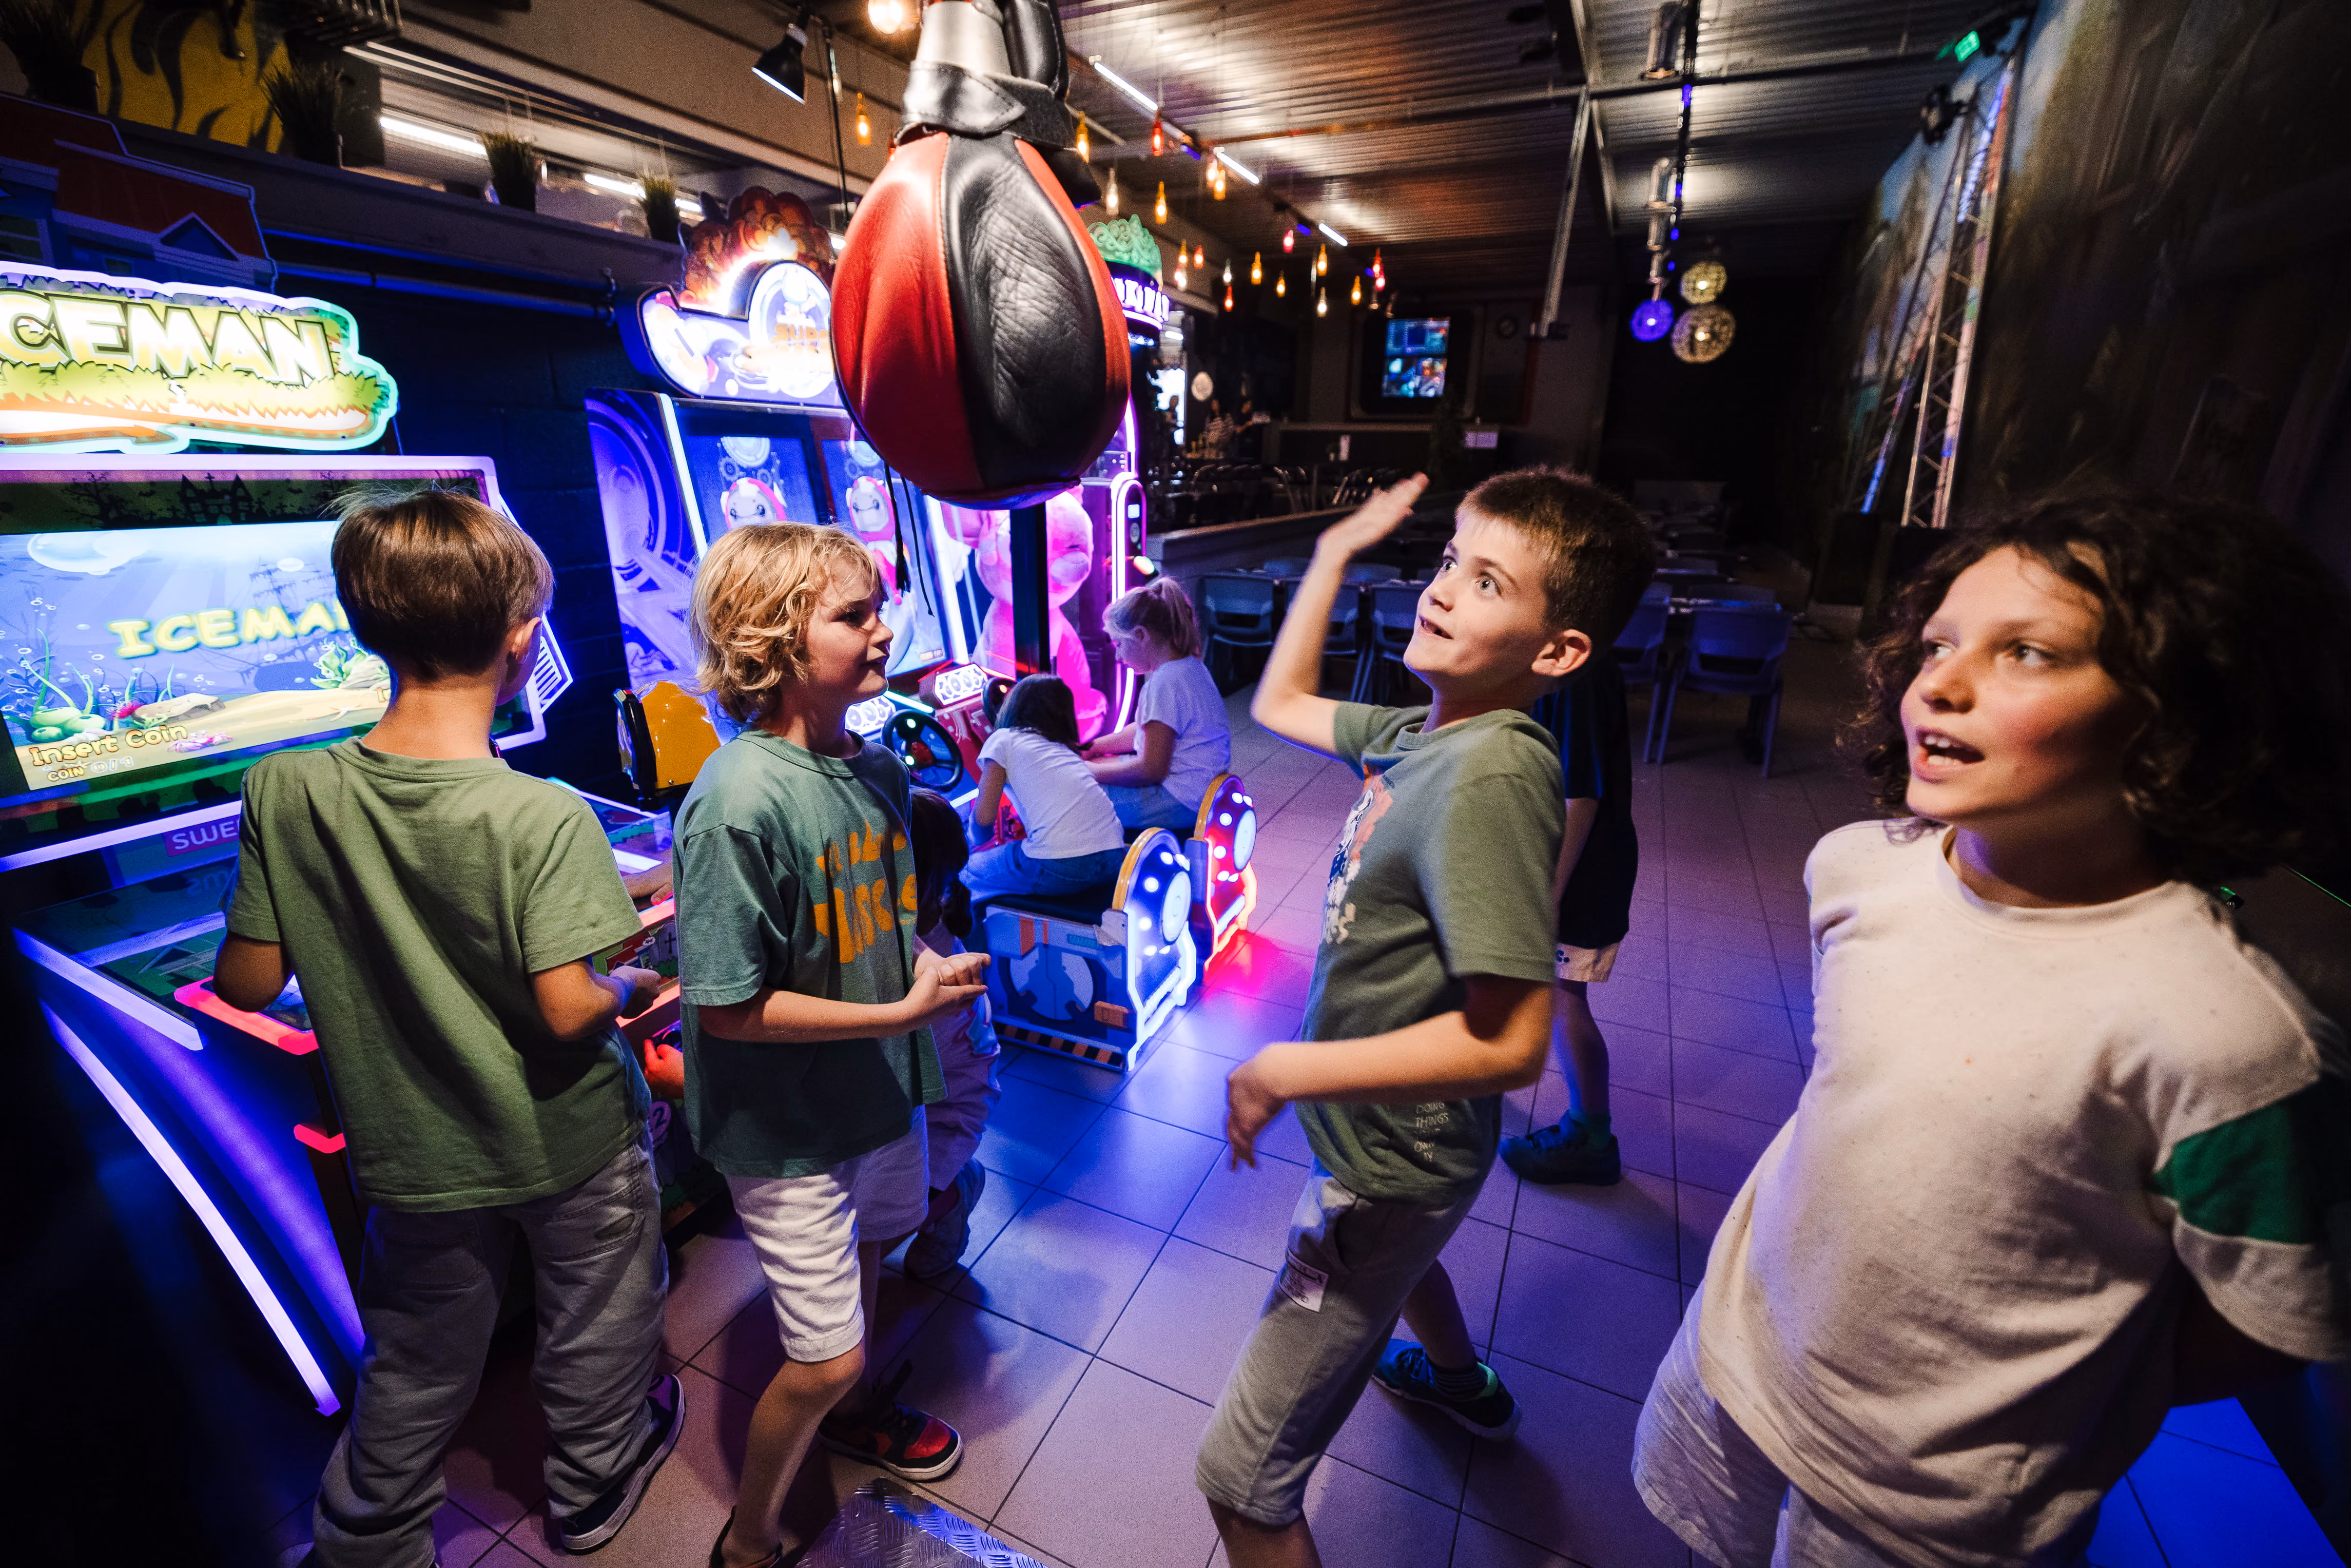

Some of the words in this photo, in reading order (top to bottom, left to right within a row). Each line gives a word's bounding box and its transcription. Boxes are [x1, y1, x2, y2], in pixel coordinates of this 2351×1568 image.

[29, 735, 119, 766] Insert
[125, 725, 187, 748] Coin
[47, 766, 84, 782] COIN
[1415, 1112, 1449, 1128] THINGS
